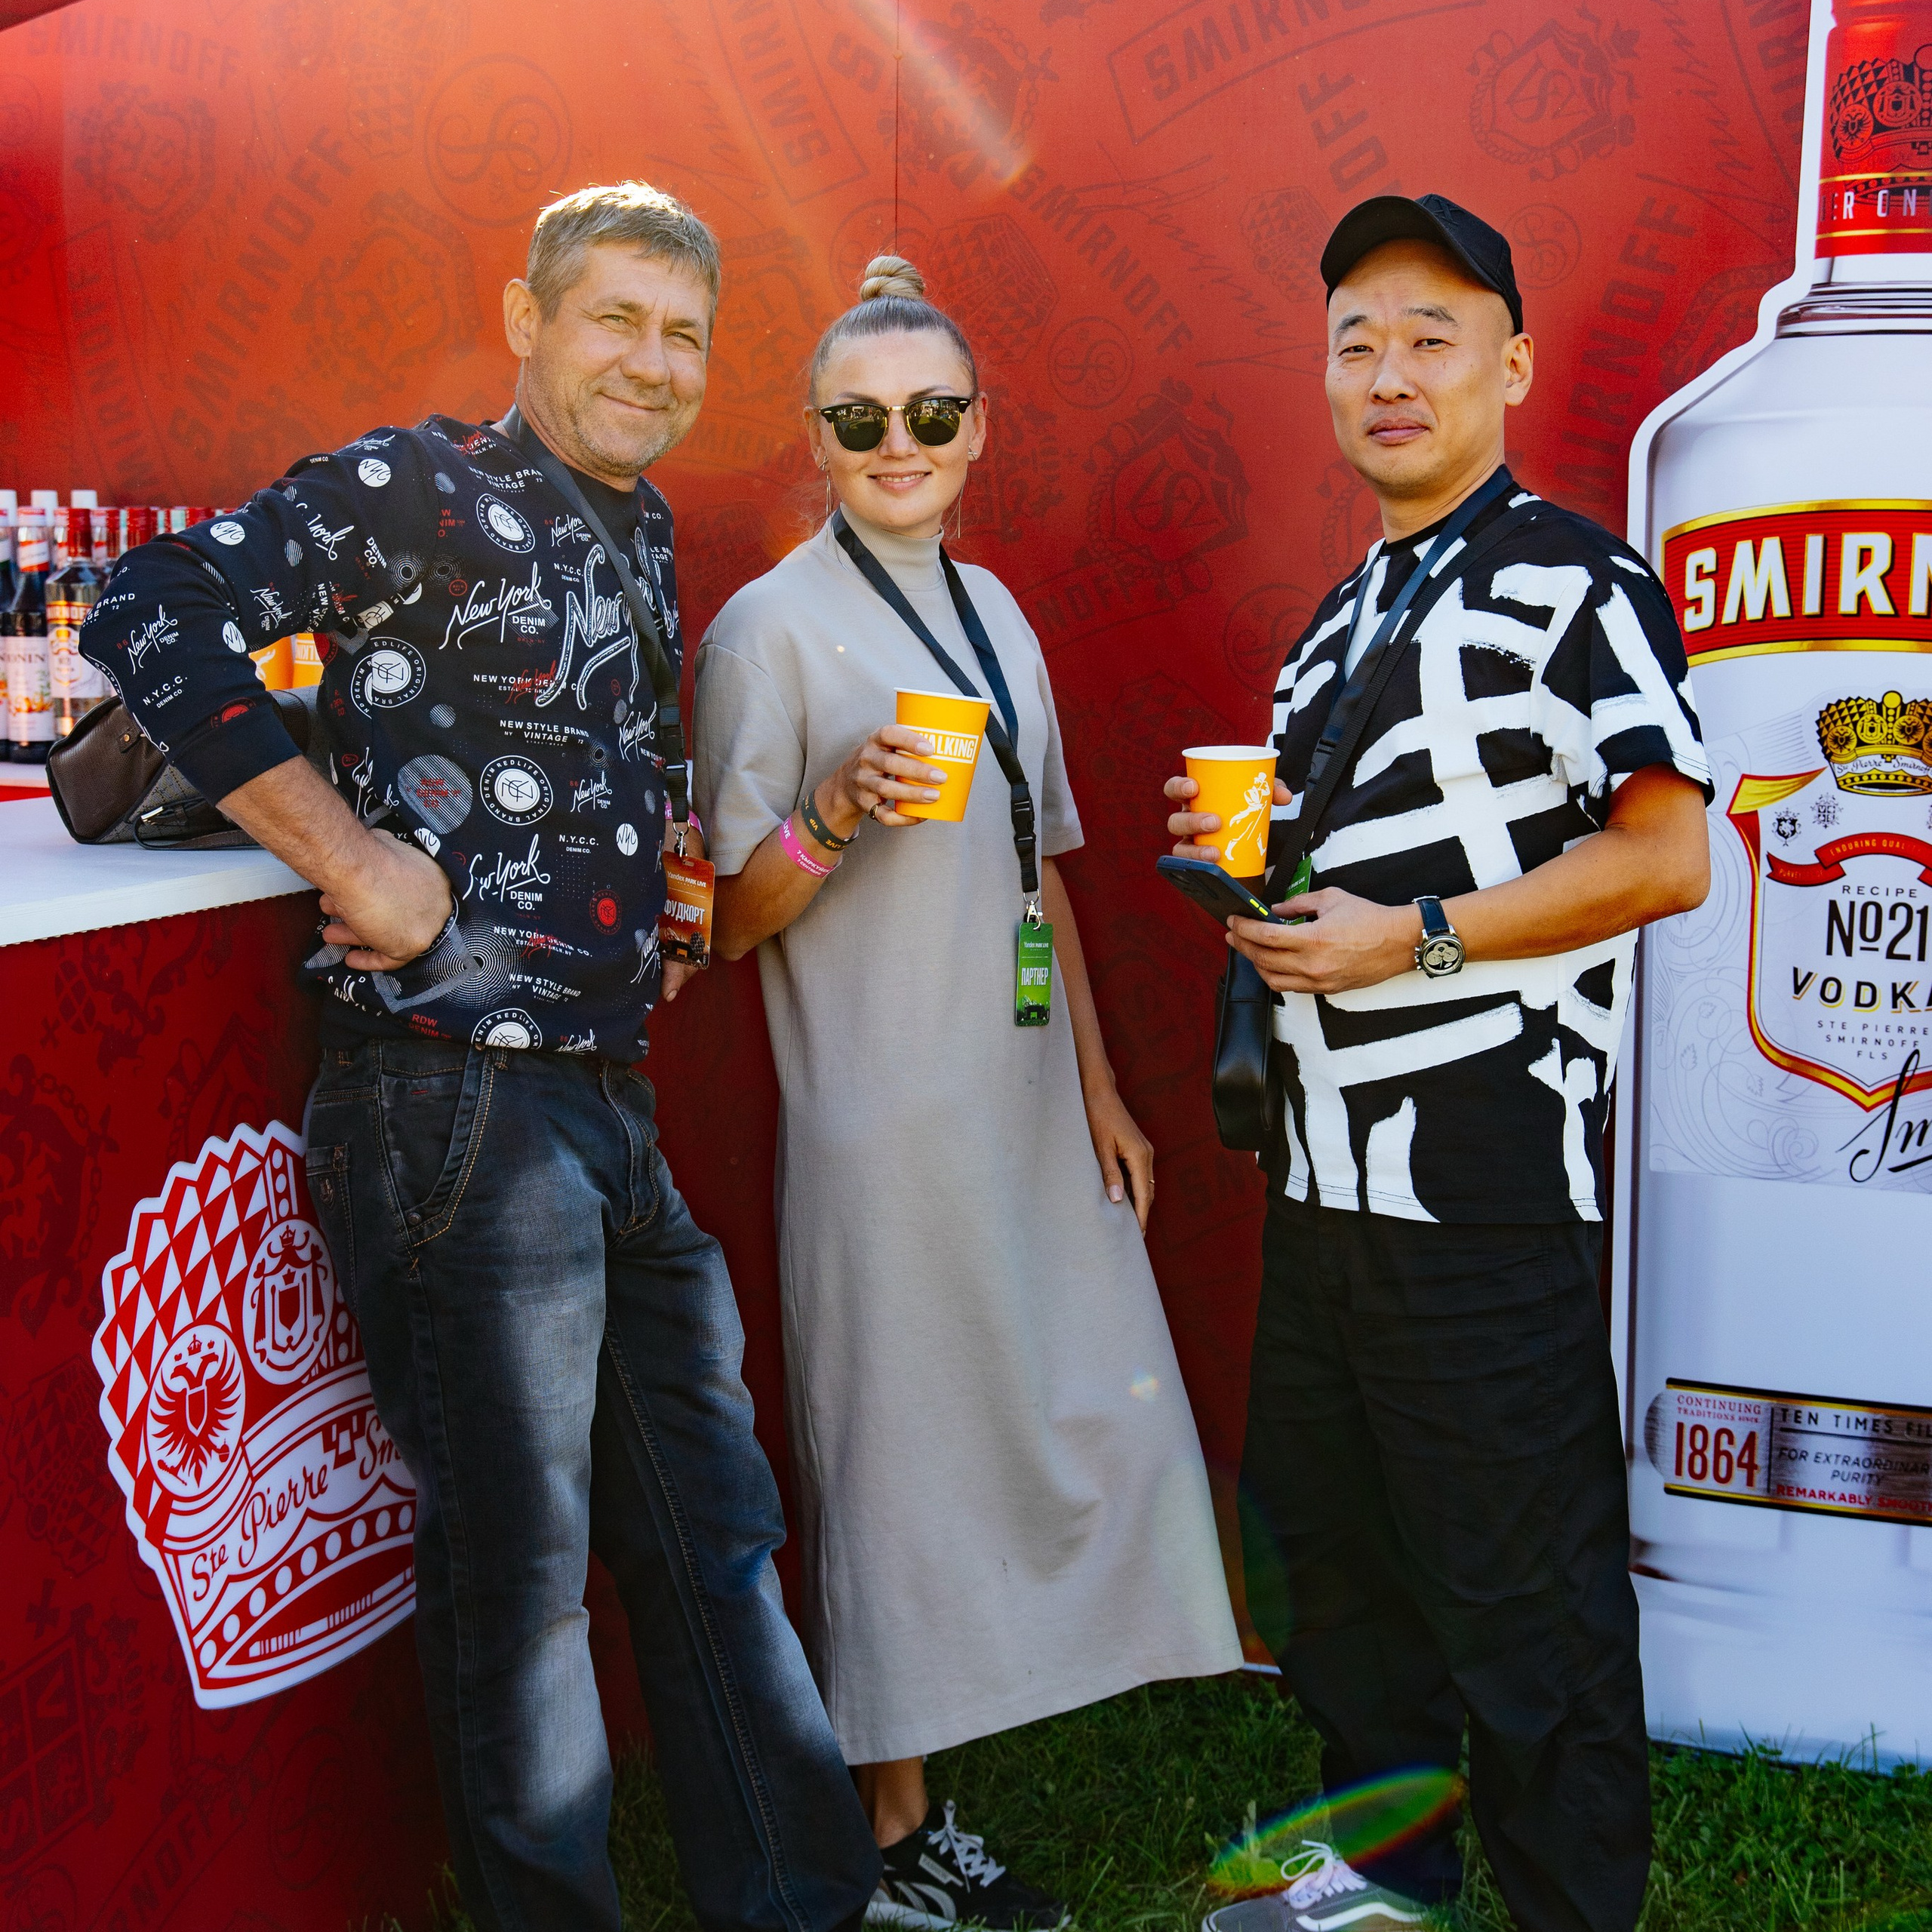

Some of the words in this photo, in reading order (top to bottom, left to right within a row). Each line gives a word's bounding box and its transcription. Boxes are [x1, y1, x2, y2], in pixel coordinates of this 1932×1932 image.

[27, 11, 240, 89] SMIRNOFF
[1010, 165, 1195, 355] SMIRNOFF
[169, 126, 357, 462] SMIRNOFF
[1549, 197, 1698, 517] MIRNOFF
[67, 266, 159, 495] MIRNOFF
[432, 431, 448, 440] NEW
[487, 479, 525, 489] VINTAGE
[364, 549, 377, 568] CO.
[366, 537, 387, 568] DENIM
[554, 562, 585, 577] N.Y.C.C.
[97, 592, 135, 608] BRAND
[498, 561, 552, 642] York
[438, 580, 501, 650] New
[512, 616, 546, 626] DENIM
[159, 632, 179, 643] DENIM
[521, 625, 539, 635] CO.
[354, 668, 365, 699] DENIM
[397, 659, 423, 702] ORIGINAL
[473, 674, 497, 683] NEW
[143, 675, 188, 706] N.Y.C.C.
[156, 694, 174, 708] DENIM
[500, 720, 523, 730] NEW
[526, 722, 559, 733] STYLE
[565, 726, 589, 737] BRAND
[524, 731, 568, 743] VINTAGE
[497, 759, 538, 777] REDLIFE
[1851, 759, 1882, 772] Pierre
[484, 767, 495, 798] DENIM
[525, 779, 550, 820] ORIGINAL
[489, 801, 521, 823] BRAND
[809, 818, 819, 831] VIP
[558, 834, 599, 846] N.Y.C.C.
[826, 839, 839, 849] LIVE
[1829, 839, 1877, 857] ENDURING
[495, 833, 551, 903] York
[667, 872, 685, 882] Yandex
[510, 891, 543, 902] DENIM
[1842, 884, 1918, 898] RECIPE
[518, 900, 536, 911] CO.
[664, 899, 705, 925] ФУДКОРТ
[494, 926, 516, 936] NEW
[577, 948, 592, 958] CO.
[509, 974, 533, 983] NEW
[535, 977, 562, 992] STYLE
[562, 986, 581, 998] BRAND
[1021, 968, 1049, 986] ПАРТНЕР
[532, 985, 561, 1001] VINTAGE
[411, 1014, 438, 1027] RDW
[496, 1012, 534, 1031] REDLIFE
[1817, 1020, 1847, 1030] STE
[1862, 1023, 1929, 1035] PIERRE
[408, 1023, 439, 1038] DENIM
[475, 1020, 493, 1042] ENIM
[1826, 1035, 1919, 1048] SMIRNOFF
[1857, 1050, 1888, 1060] FLS
[1677, 1395, 1761, 1415] CONTINUING
[1678, 1407, 1735, 1421] TRADITIONS
[1780, 1407, 1820, 1426] TEN
[1834, 1414, 1894, 1433] TIMES
[1675, 1421, 1758, 1488] 1864
[1778, 1447, 1809, 1462] FOR
[1831, 1469, 1884, 1487] PURITY
[1777, 1484, 1872, 1506] REMARKABLY
[192, 1544, 228, 1601] Ste
[238, 1464, 329, 1565] Pierre
